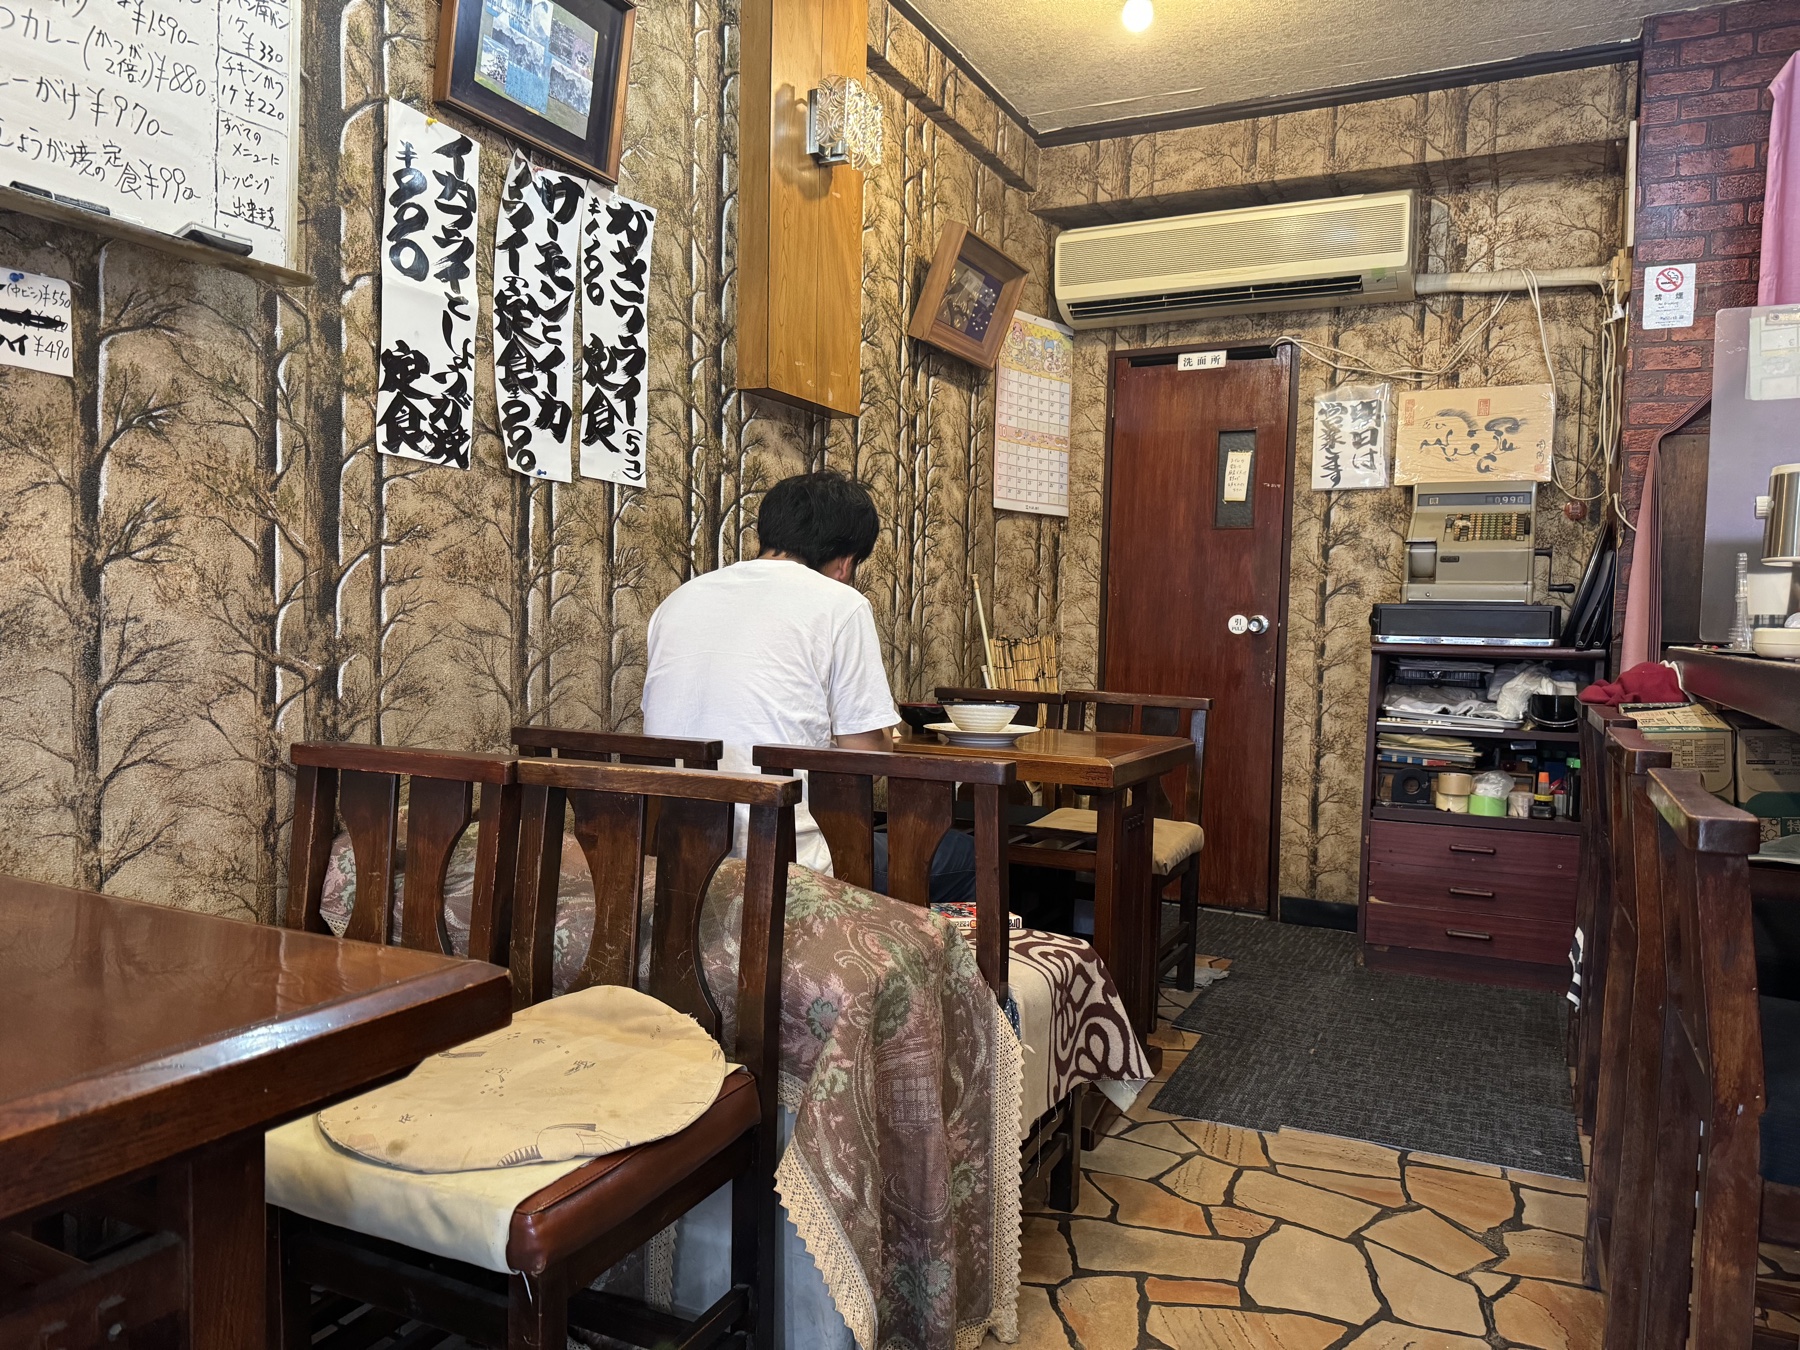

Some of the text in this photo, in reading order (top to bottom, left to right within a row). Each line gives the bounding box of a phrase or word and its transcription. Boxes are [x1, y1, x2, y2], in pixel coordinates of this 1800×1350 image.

[154, 51, 207, 97] ¥880
[244, 88, 285, 121] ¥220
[220, 117, 262, 146] すべての
[232, 143, 280, 166] メニューに
[221, 166, 275, 195] トッピング
[33, 335, 70, 361] ¥490
[1183, 354, 1221, 367] 洗面所
[1318, 402, 1349, 489] 営業します
[1349, 400, 1381, 471] 明日は
